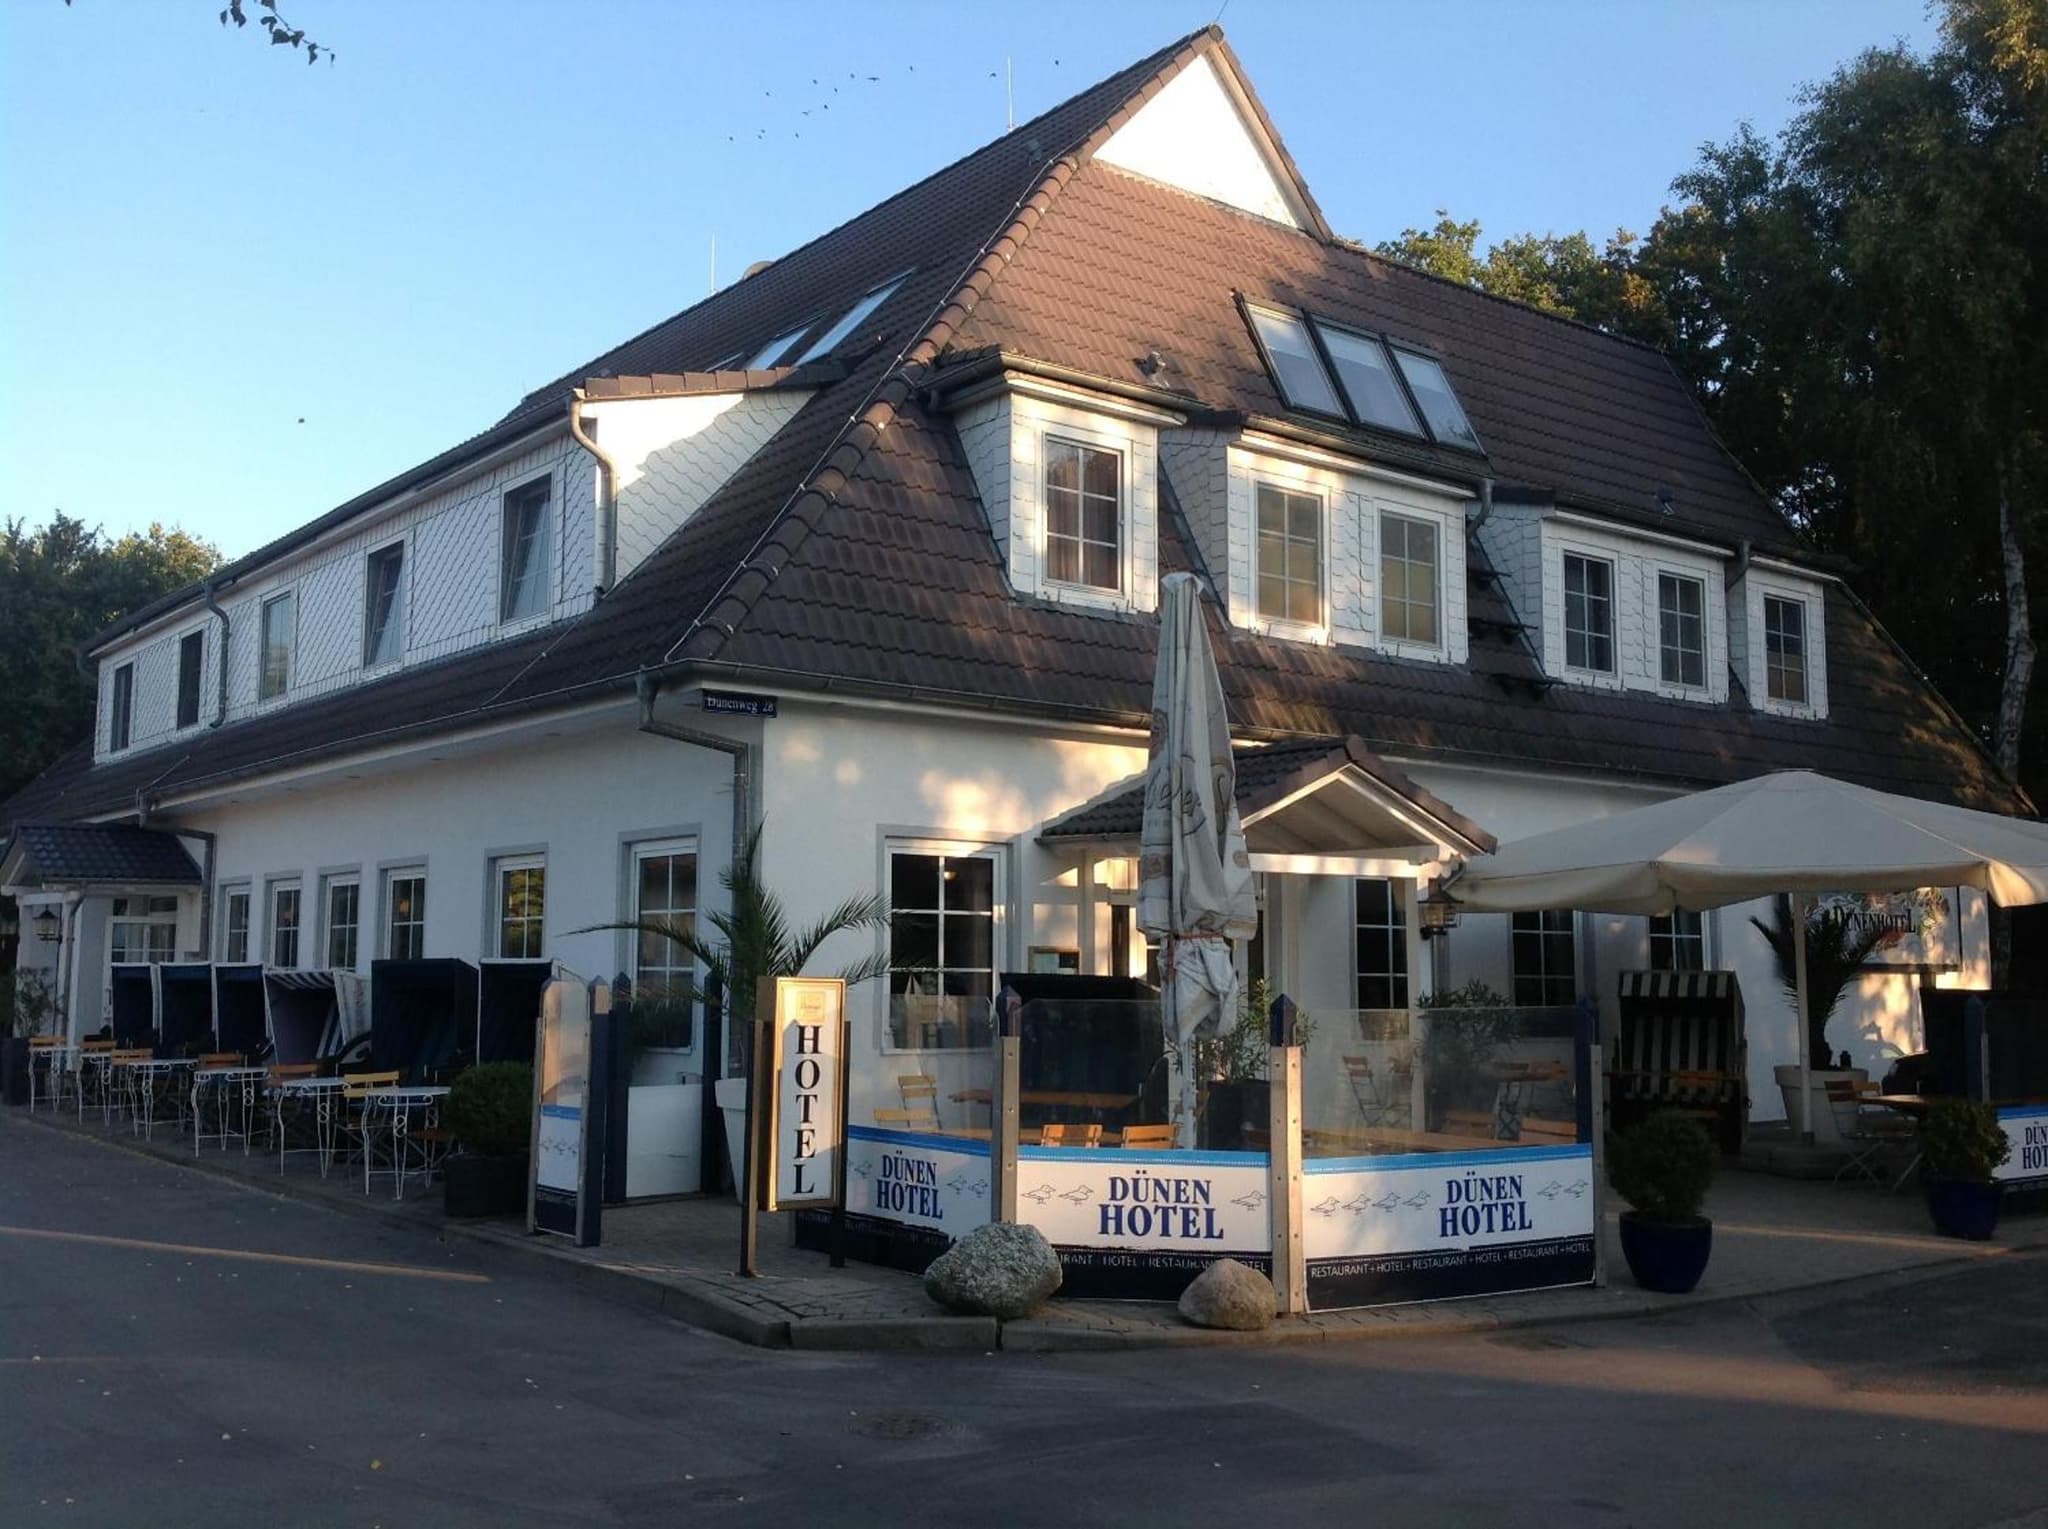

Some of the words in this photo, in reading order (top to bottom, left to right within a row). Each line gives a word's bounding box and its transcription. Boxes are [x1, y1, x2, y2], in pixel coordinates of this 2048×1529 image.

[792, 1025, 822, 1194] HOTEL
[882, 1150, 937, 1186] DÜNEN
[877, 1178, 943, 1219] HOTEL
[1109, 1170, 1212, 1204] DÜNEN
[1446, 1170, 1523, 1204] DÜNEN
[1098, 1203, 1224, 1239] HOTEL
[1439, 1201, 1533, 1237] HOTEL
[1103, 1255, 1137, 1266] HOTEL
[1311, 1263, 1370, 1278] RESTAURANT
[1376, 1261, 1405, 1273] HOTEL
[1412, 1255, 1467, 1270] RESTAURANT
[1475, 1252, 1502, 1265] HOTEL
[1508, 1244, 1559, 1261] RESTAURANT
[1566, 1242, 1591, 1254] HOTEL
